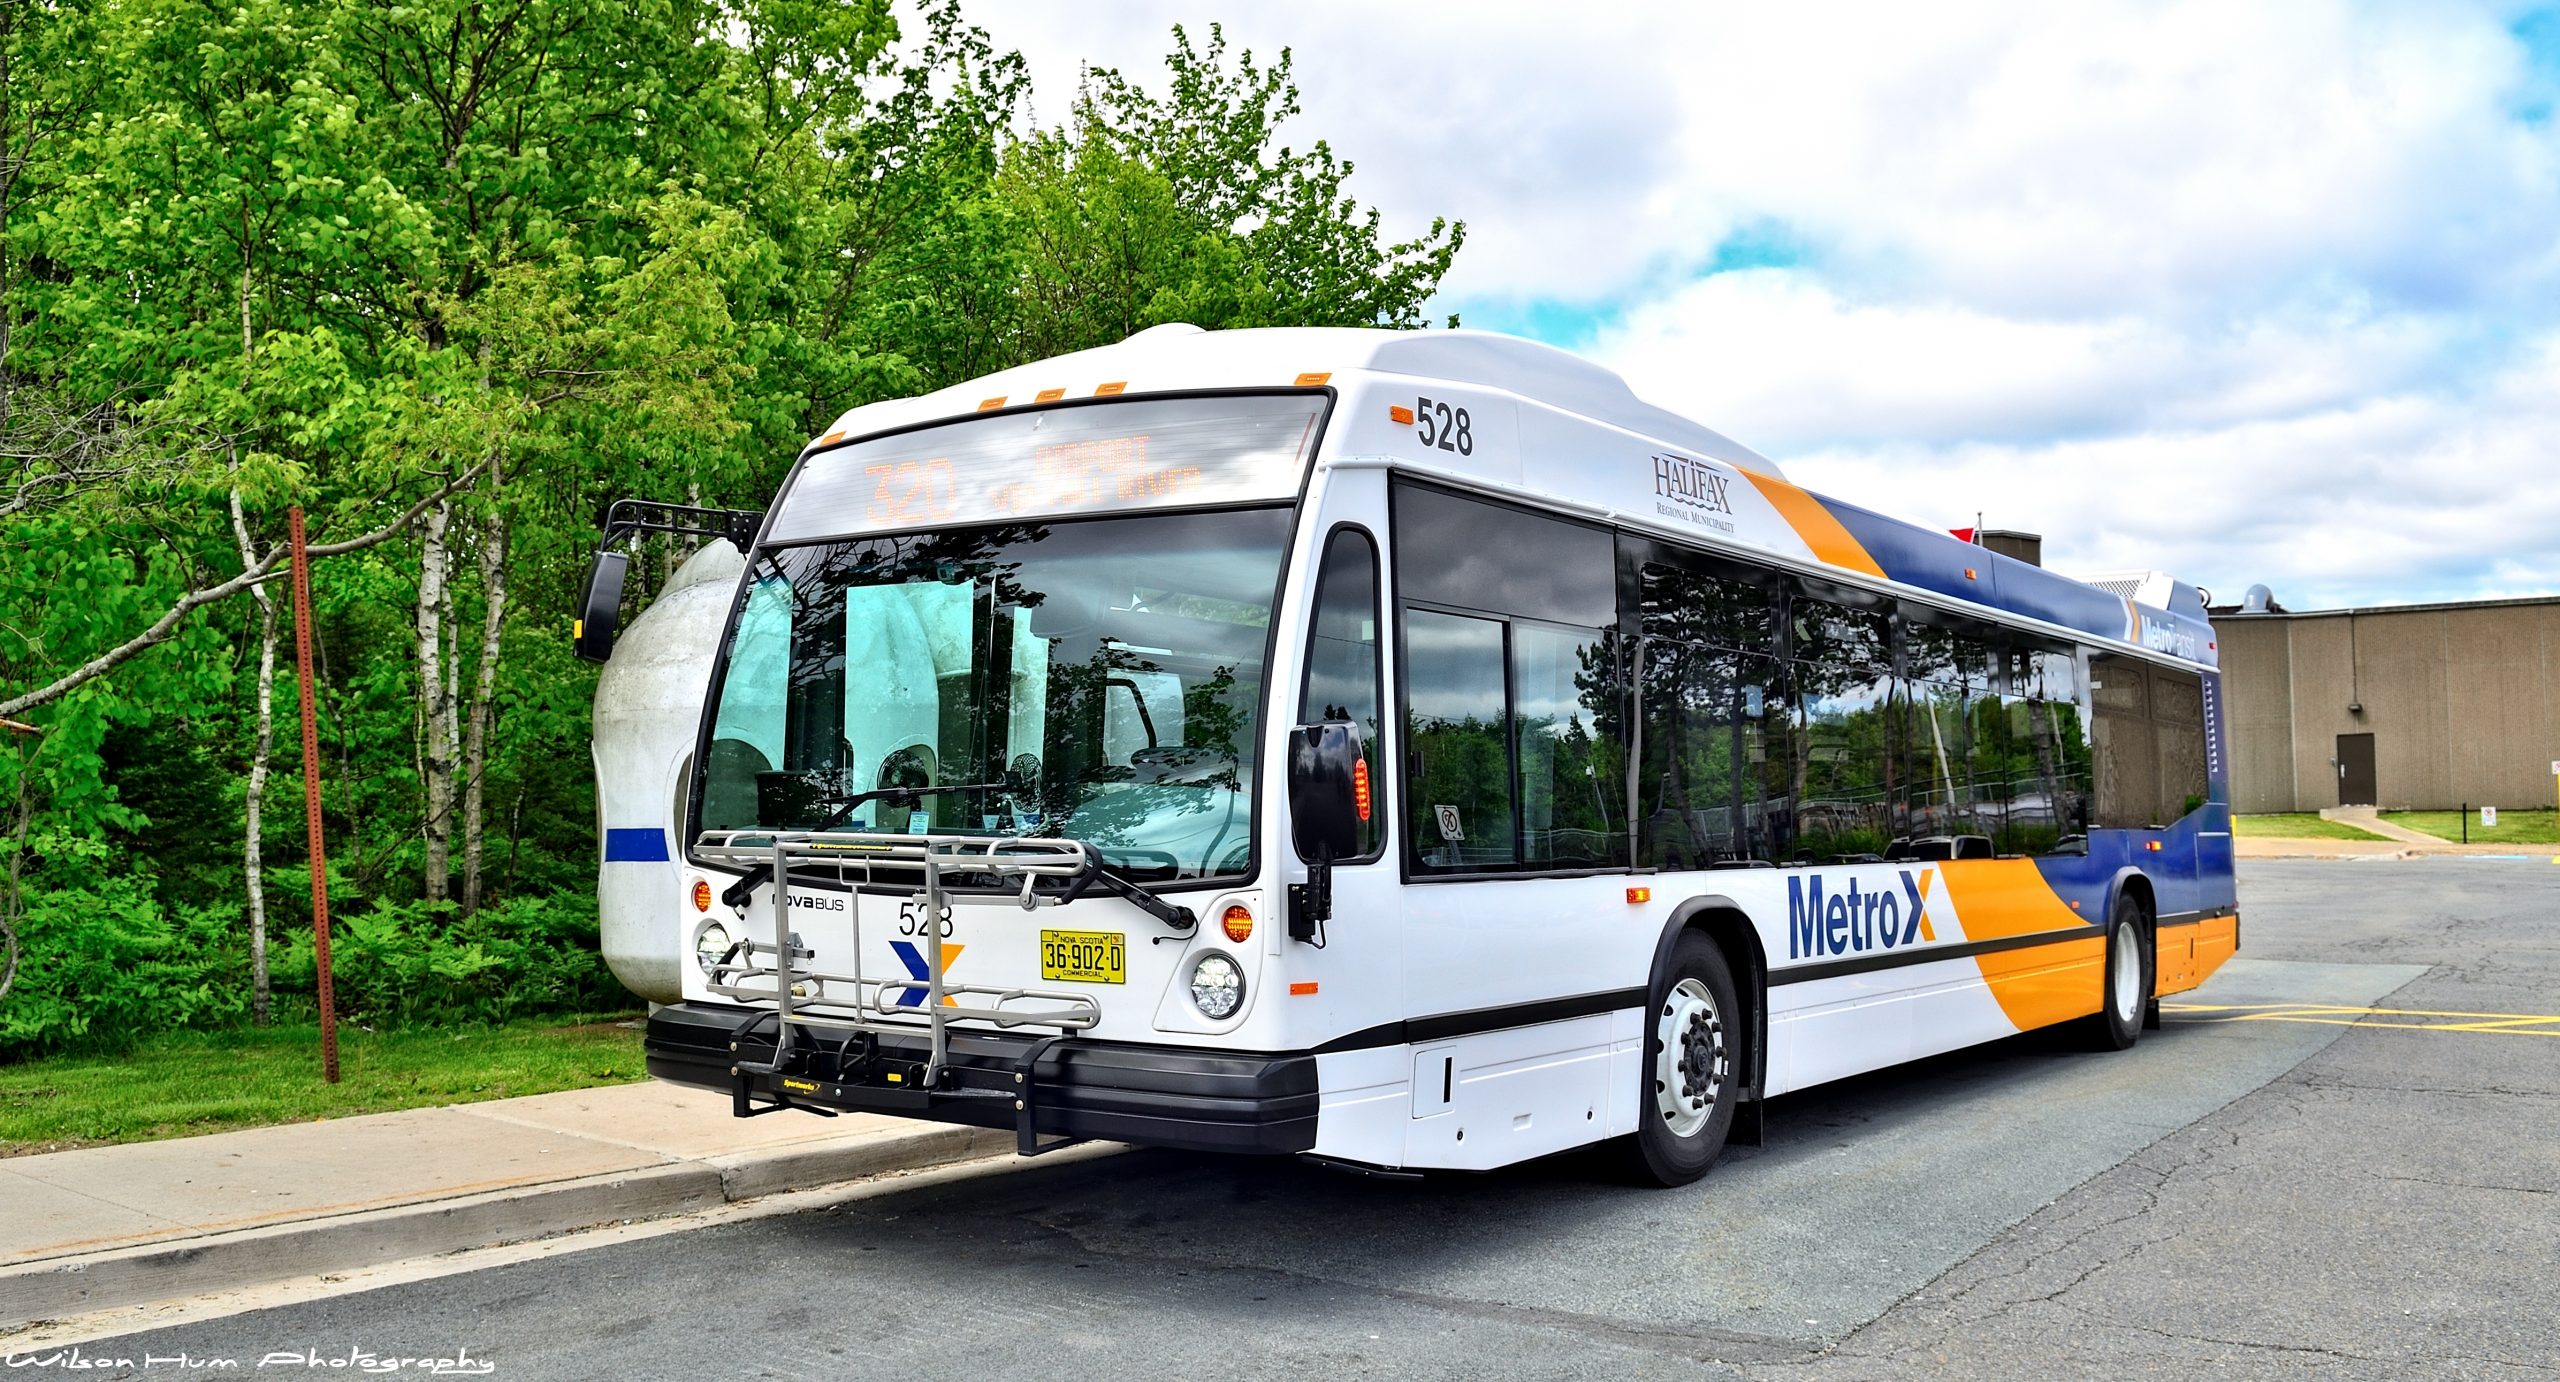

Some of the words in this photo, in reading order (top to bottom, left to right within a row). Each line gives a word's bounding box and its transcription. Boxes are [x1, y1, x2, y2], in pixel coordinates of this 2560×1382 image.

[1417, 396, 1473, 456] 528
[865, 457, 956, 524] 320
[1651, 455, 1733, 515] HALIFAX
[899, 902, 954, 938] 528
[1060, 936, 1077, 944] NOVA
[1080, 937, 1104, 945] SCOTIA
[1062, 969, 1103, 978] COMMERCIAL
